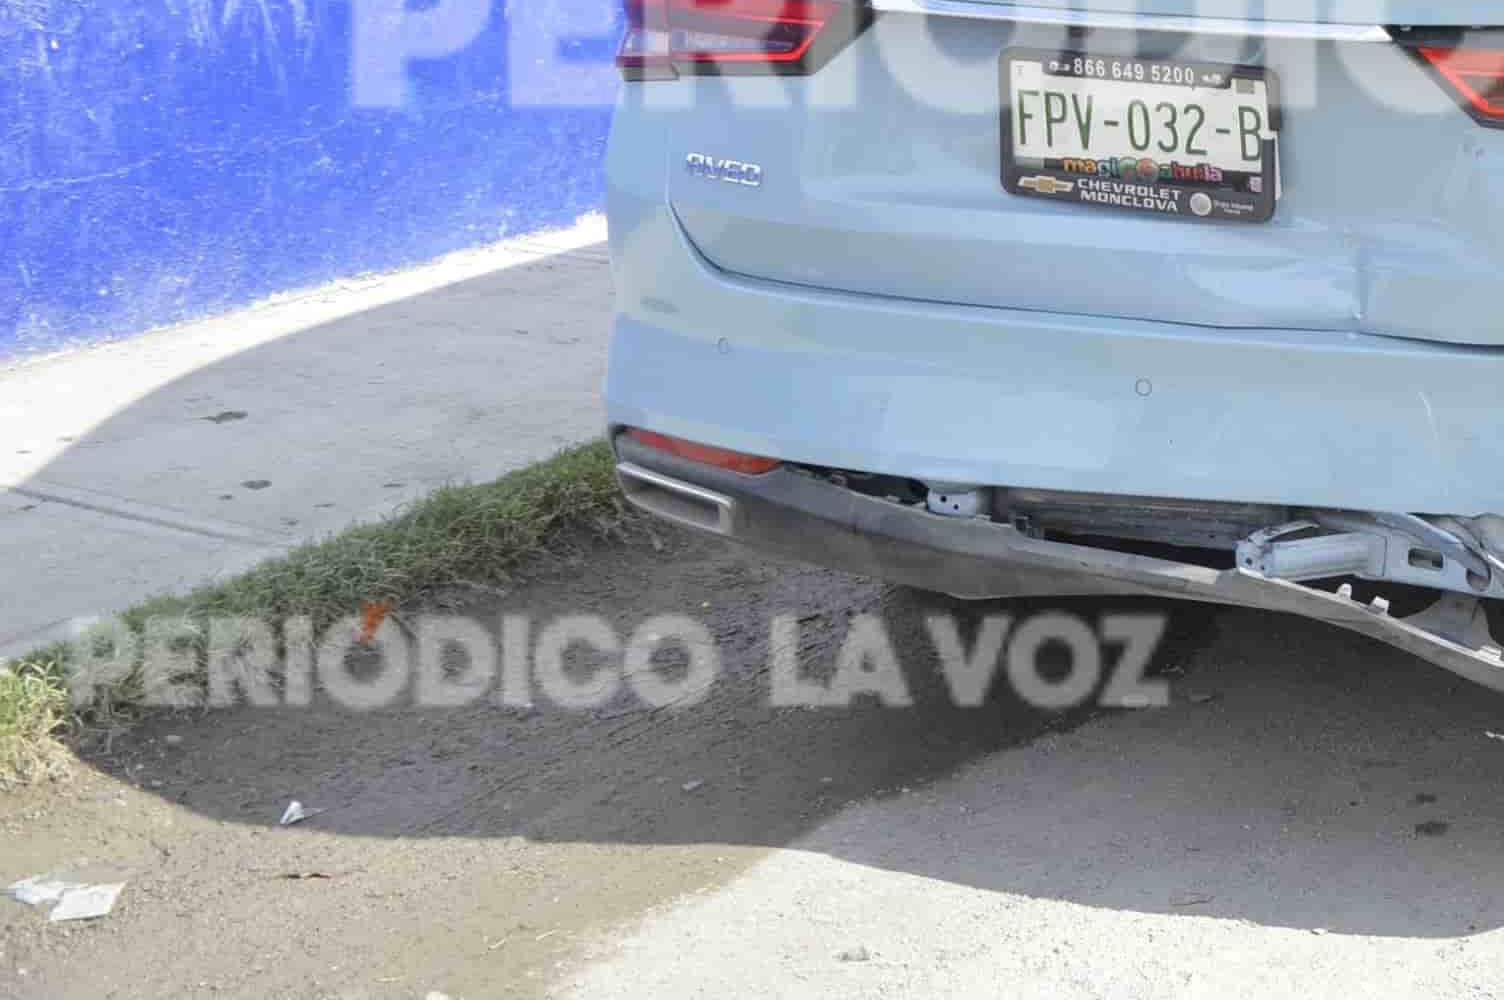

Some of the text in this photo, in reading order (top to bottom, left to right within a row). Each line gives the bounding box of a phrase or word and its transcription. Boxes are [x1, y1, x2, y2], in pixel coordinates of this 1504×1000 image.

[1073, 58, 1194, 85] 866 649 5200
[1016, 89, 1263, 162] FPV-032-B
[1076, 177, 1183, 203] CHEVROLET
[1079, 188, 1179, 213] MONCLOVA
